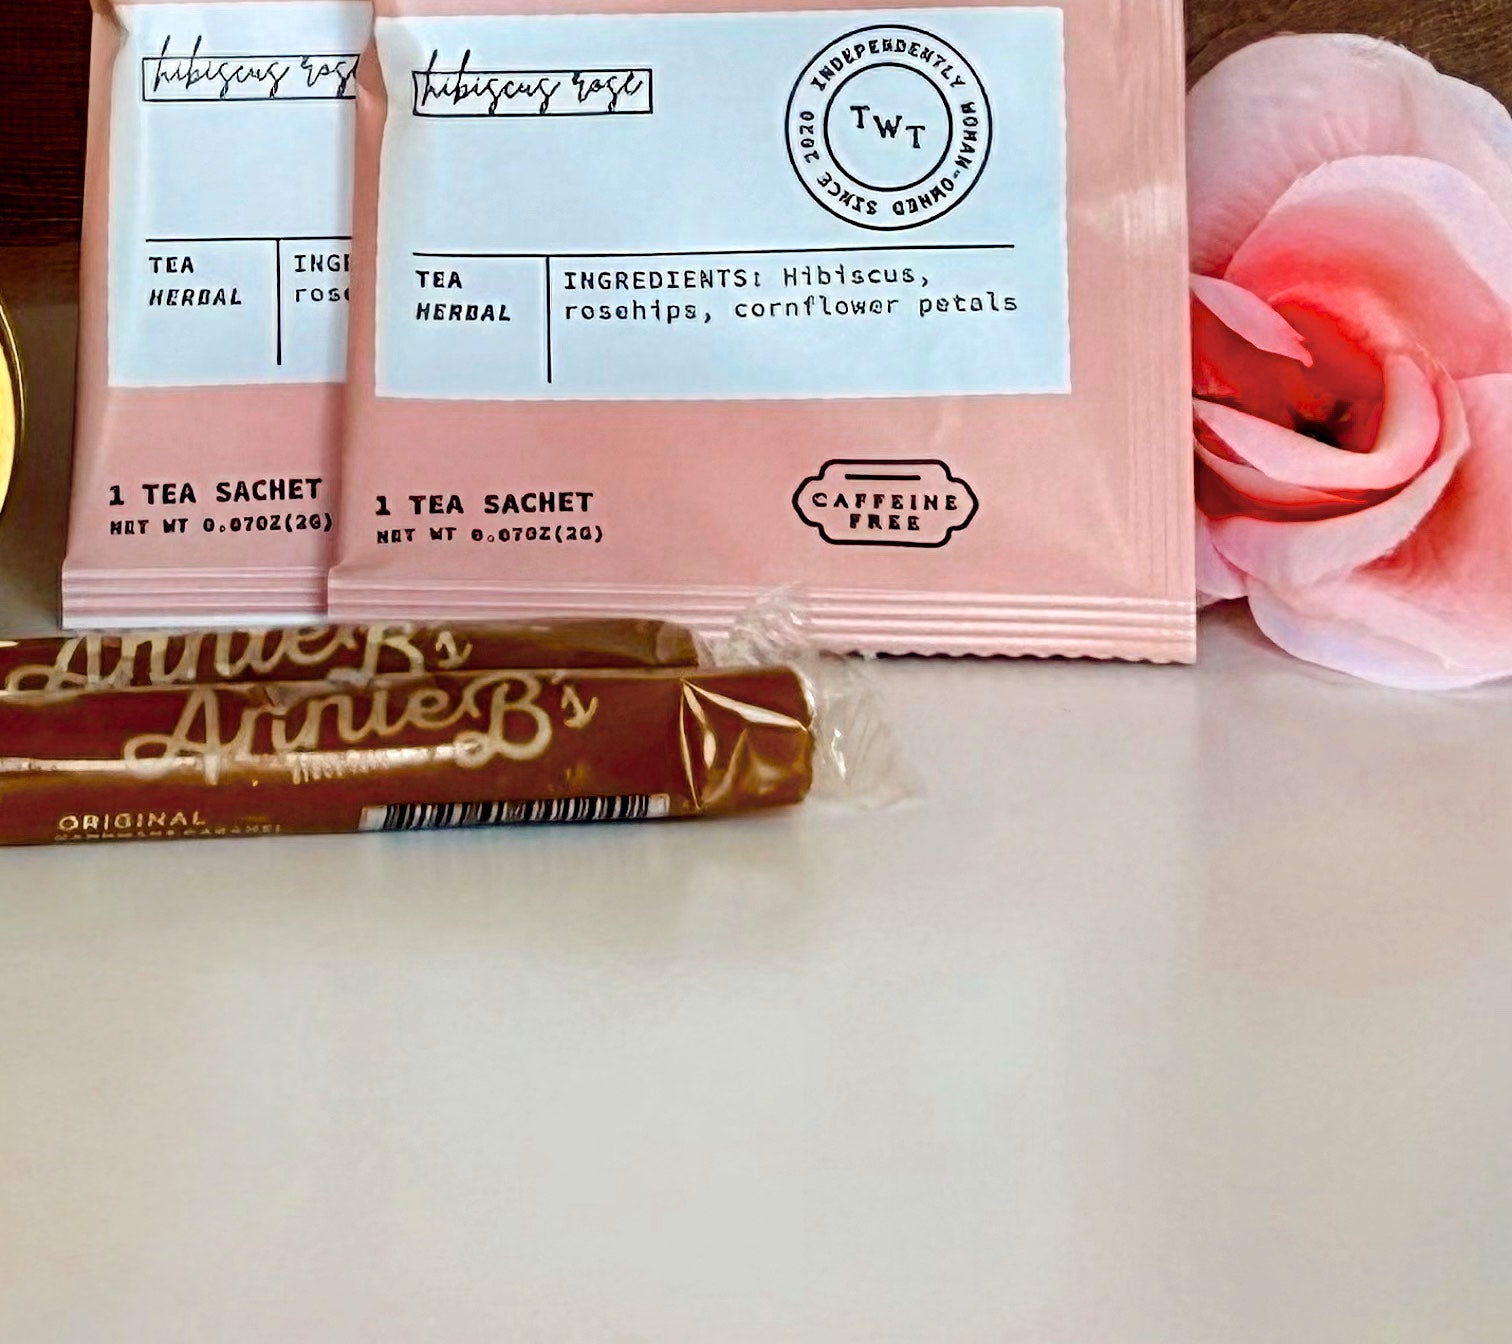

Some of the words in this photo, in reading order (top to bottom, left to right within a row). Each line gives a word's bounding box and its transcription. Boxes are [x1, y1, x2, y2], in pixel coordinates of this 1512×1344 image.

[153, 34, 291, 100] hibiscus
[421, 49, 562, 116] hibiscus
[571, 70, 645, 113] rose
[148, 255, 195, 274] TEA
[414, 269, 463, 289] TEA
[563, 268, 762, 290] INGREDIENTS:
[783, 264, 929, 288] Hibiscus,
[148, 287, 243, 307] HERBAL
[734, 294, 900, 318] cornflower
[919, 291, 1019, 317] petals
[109, 485, 125, 506] 1
[142, 481, 197, 505] TEA
[215, 477, 324, 503] SACHET
[811, 492, 958, 511] CAFFEINE
[375, 495, 391, 516] 1
[408, 494, 465, 515] TEA
[483, 491, 595, 514] SACHET
[163, 517, 189, 534] WT
[849, 513, 920, 531] FREE
[429, 526, 458, 541] WT
[58, 810, 207, 832] ORIGINAL
